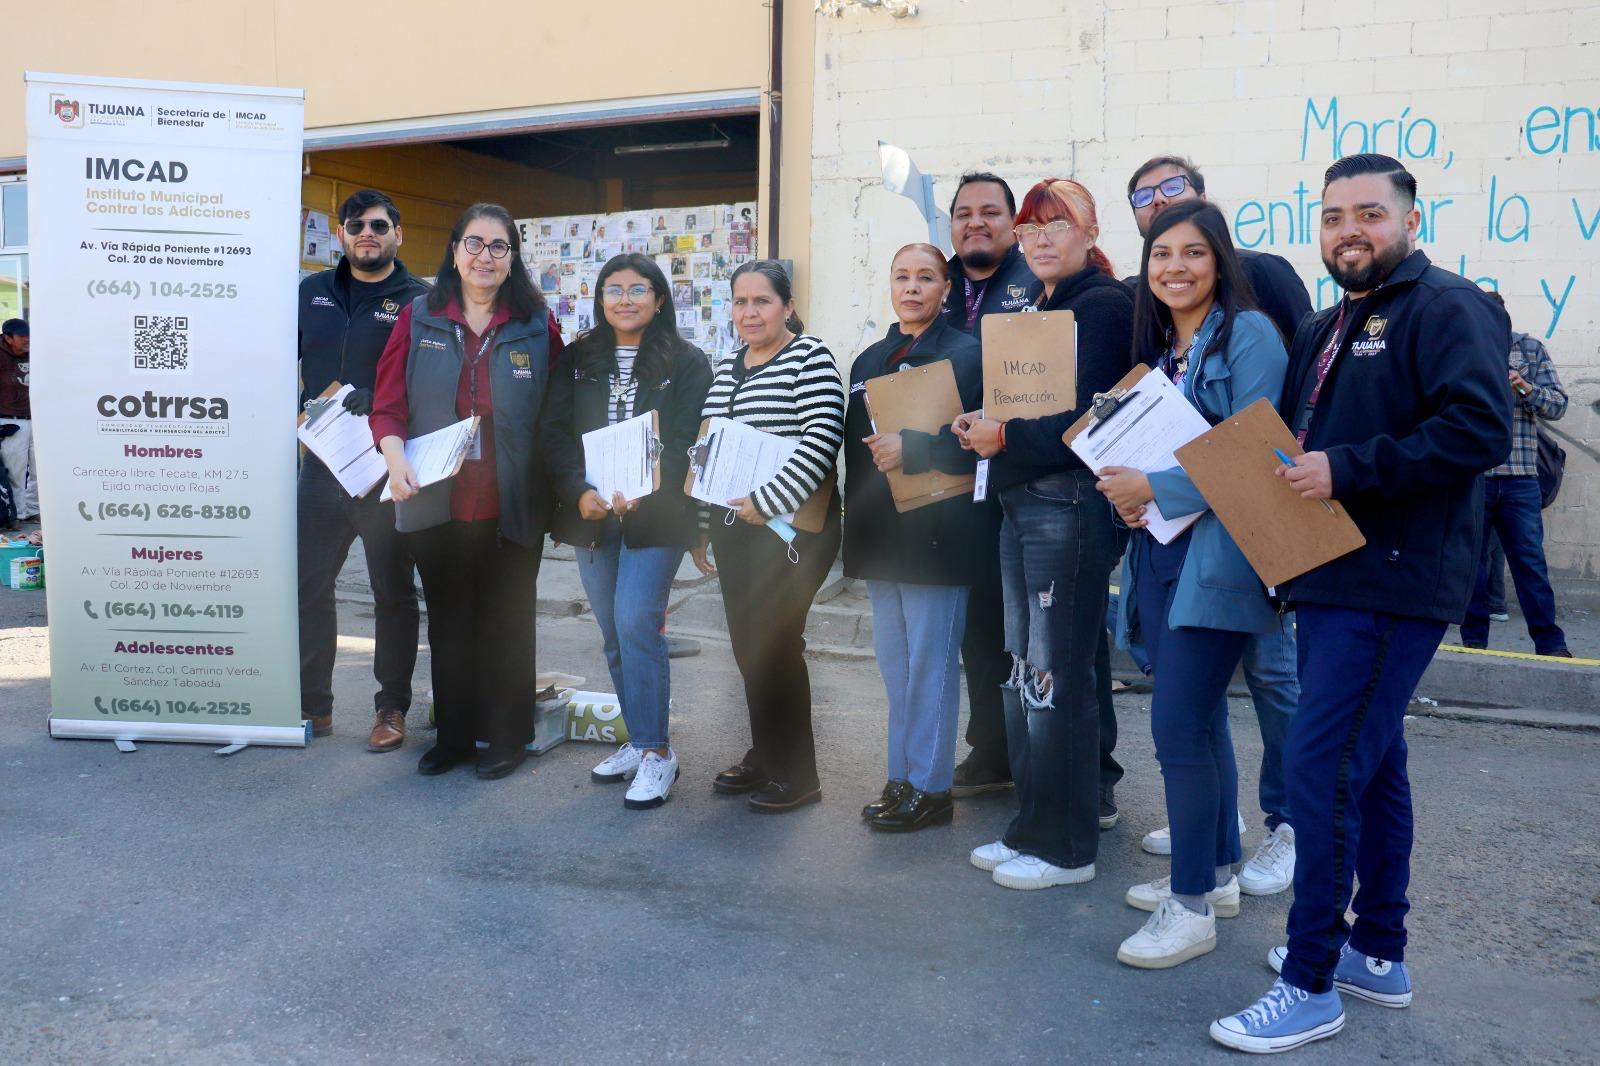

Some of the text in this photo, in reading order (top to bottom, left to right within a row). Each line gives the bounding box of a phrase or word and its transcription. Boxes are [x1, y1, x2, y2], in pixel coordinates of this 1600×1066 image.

[88, 103, 145, 117] TIJUANA
[157, 107, 226, 119] Secretaría de
[235, 111, 266, 120] IMCAD
[157, 117, 204, 128] Bienestar
[1300, 96, 1453, 169] María,
[86, 157, 189, 183] IMCAD
[86, 187, 223, 205] Instituto Municipal
[86, 201, 251, 220] Contra las Adicciones
[1488, 175, 1530, 242] la
[80, 241, 252, 256] Av. Vía Rápida Poniente #12693
[107, 254, 225, 267] Col. 20 de Noviembre
[87, 279, 238, 300] (664) 104-2525
[1001, 298, 1030, 307] TIJUANA
[1540, 275, 1576, 339] y
[1352, 340, 1386, 350] TIJUANA
[1003, 360, 1046, 376] IMCAD
[993, 388, 1057, 406] Prevención
[97, 390, 229, 420] cotrrsa
[124, 444, 203, 459] Hombres
[72, 466, 127, 478] Carretera
[130, 467, 156, 478] libre
[204, 469, 222, 480] KM
[225, 470, 249, 480] 27.5
[102, 481, 221, 495] Ejido maclovio Rojas
[98, 502, 251, 521] (664) 626-8380
[131, 546, 204, 563] Mujeres
[166, 568, 216, 578] Poniente
[219, 569, 260, 579] #12693
[110, 580, 232, 592] Col. 20 de Noviembre
[104, 601, 244, 620] (664) 104-4119
[113, 641, 235, 656] Adolescentes
[80, 663, 98, 672] Av.
[101, 663, 112, 673] El
[157, 665, 178, 675] Col.
[181, 665, 223, 676] Camino
[226, 666, 262, 677] Verde,
[123, 676, 169, 687] Sánchez
[111, 698, 252, 716] (664) 104-2525
[570, 721, 617, 743] LAS
